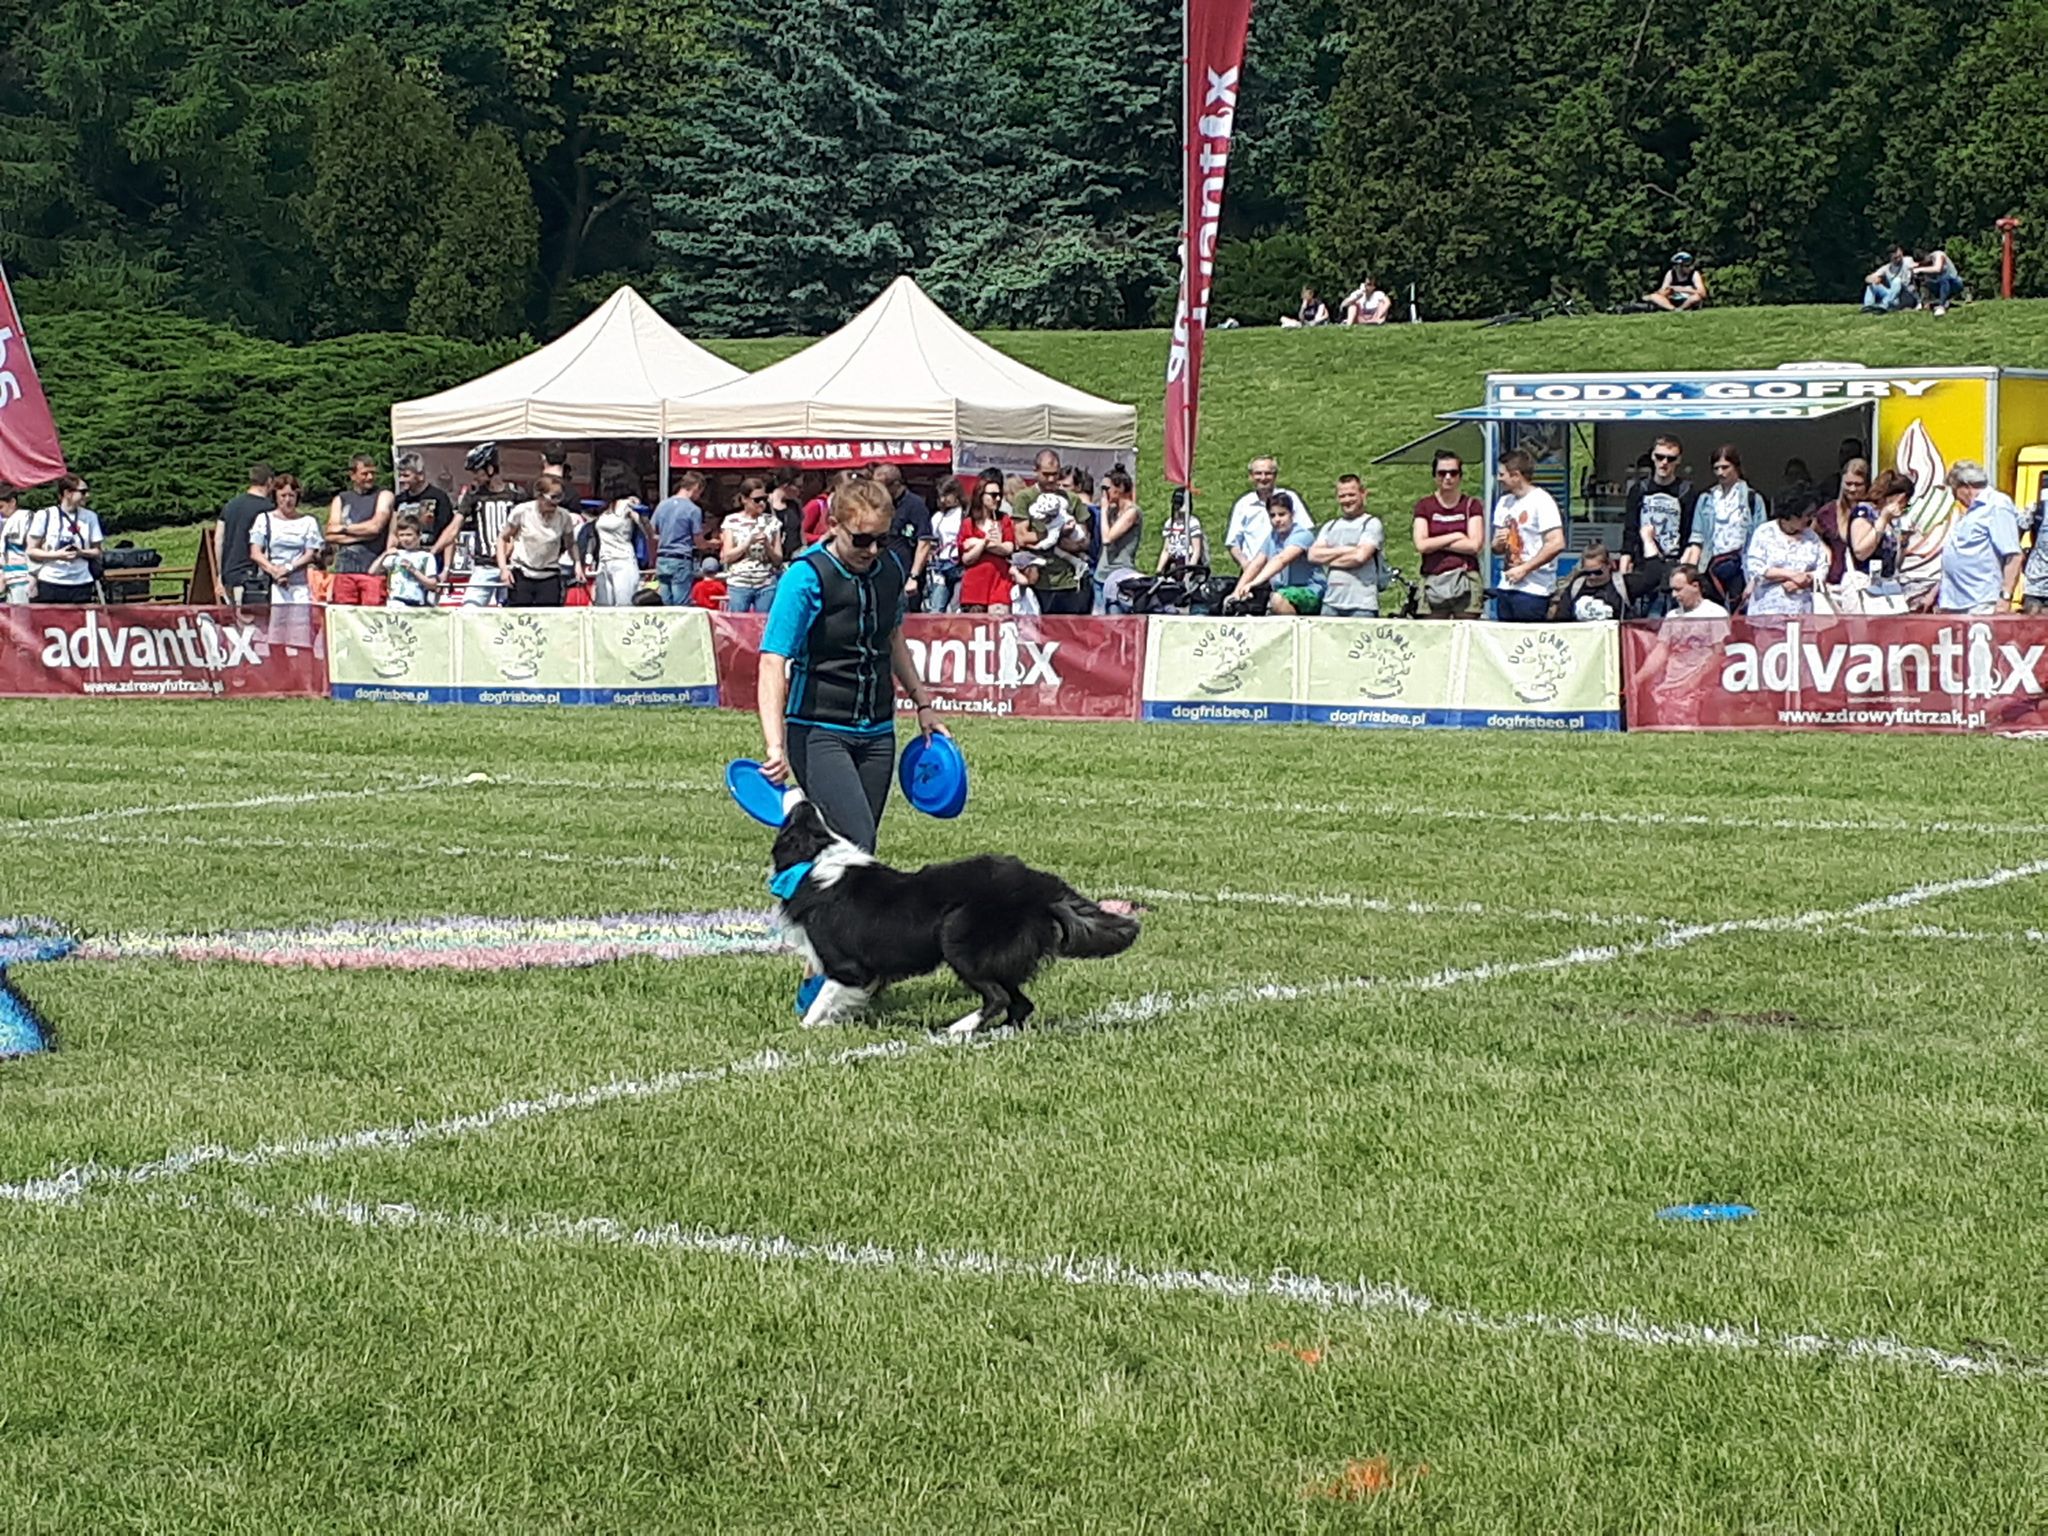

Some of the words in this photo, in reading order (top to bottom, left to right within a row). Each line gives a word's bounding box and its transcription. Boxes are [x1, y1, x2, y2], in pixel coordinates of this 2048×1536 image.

[1500, 384, 1682, 401] LODY,
[1704, 380, 1940, 399] GOFRY
[860, 441, 915, 457] KAWA
[42, 610, 262, 671] advantix
[1721, 621, 2046, 699] advantix
[1172, 705, 1268, 720] dogfrisbee.pl
[1330, 709, 1425, 725] dogfrisbee.pl
[1487, 713, 1584, 730] dogfrisbee.pl
[1778, 706, 1986, 729] www.zdrowyfutrzak.pl
